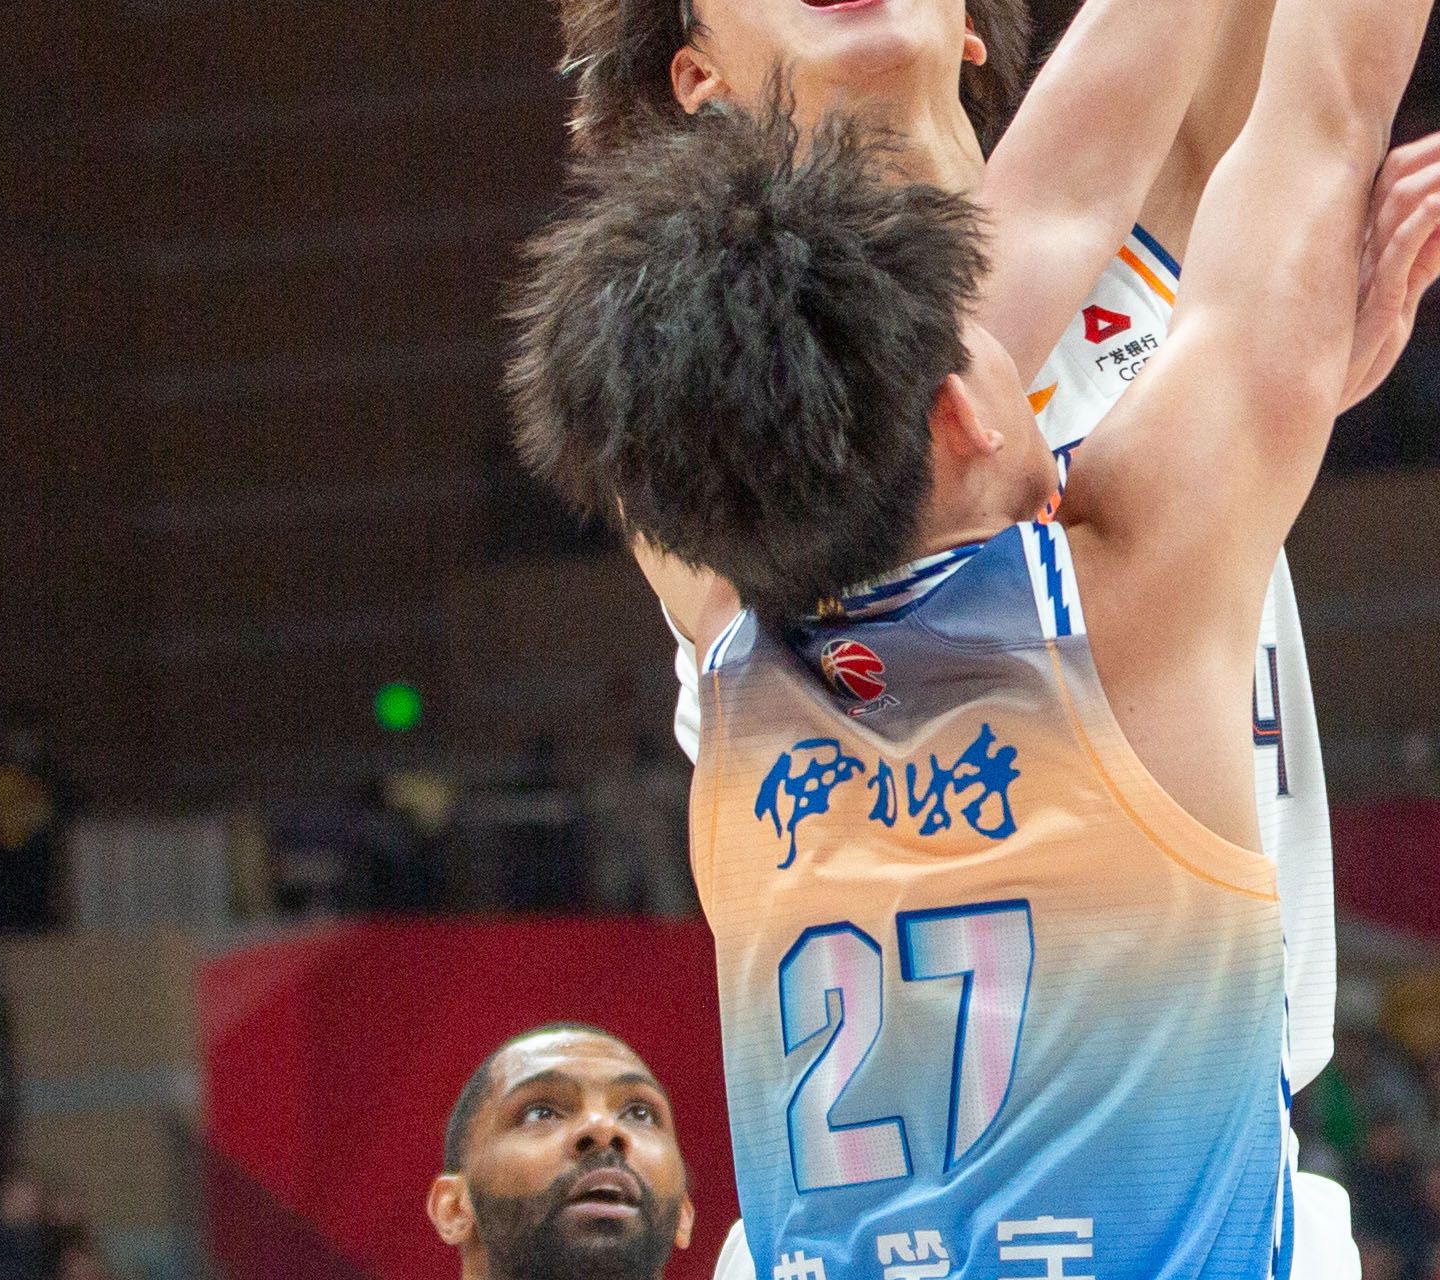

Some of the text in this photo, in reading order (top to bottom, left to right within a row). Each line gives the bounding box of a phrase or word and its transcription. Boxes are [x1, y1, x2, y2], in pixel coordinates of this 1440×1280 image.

[1095, 333, 1159, 372] 广发银行
[1118, 356, 1151, 381] CG
[754, 722, 1021, 871] 伊力特
[778, 898, 1036, 1195] 27
